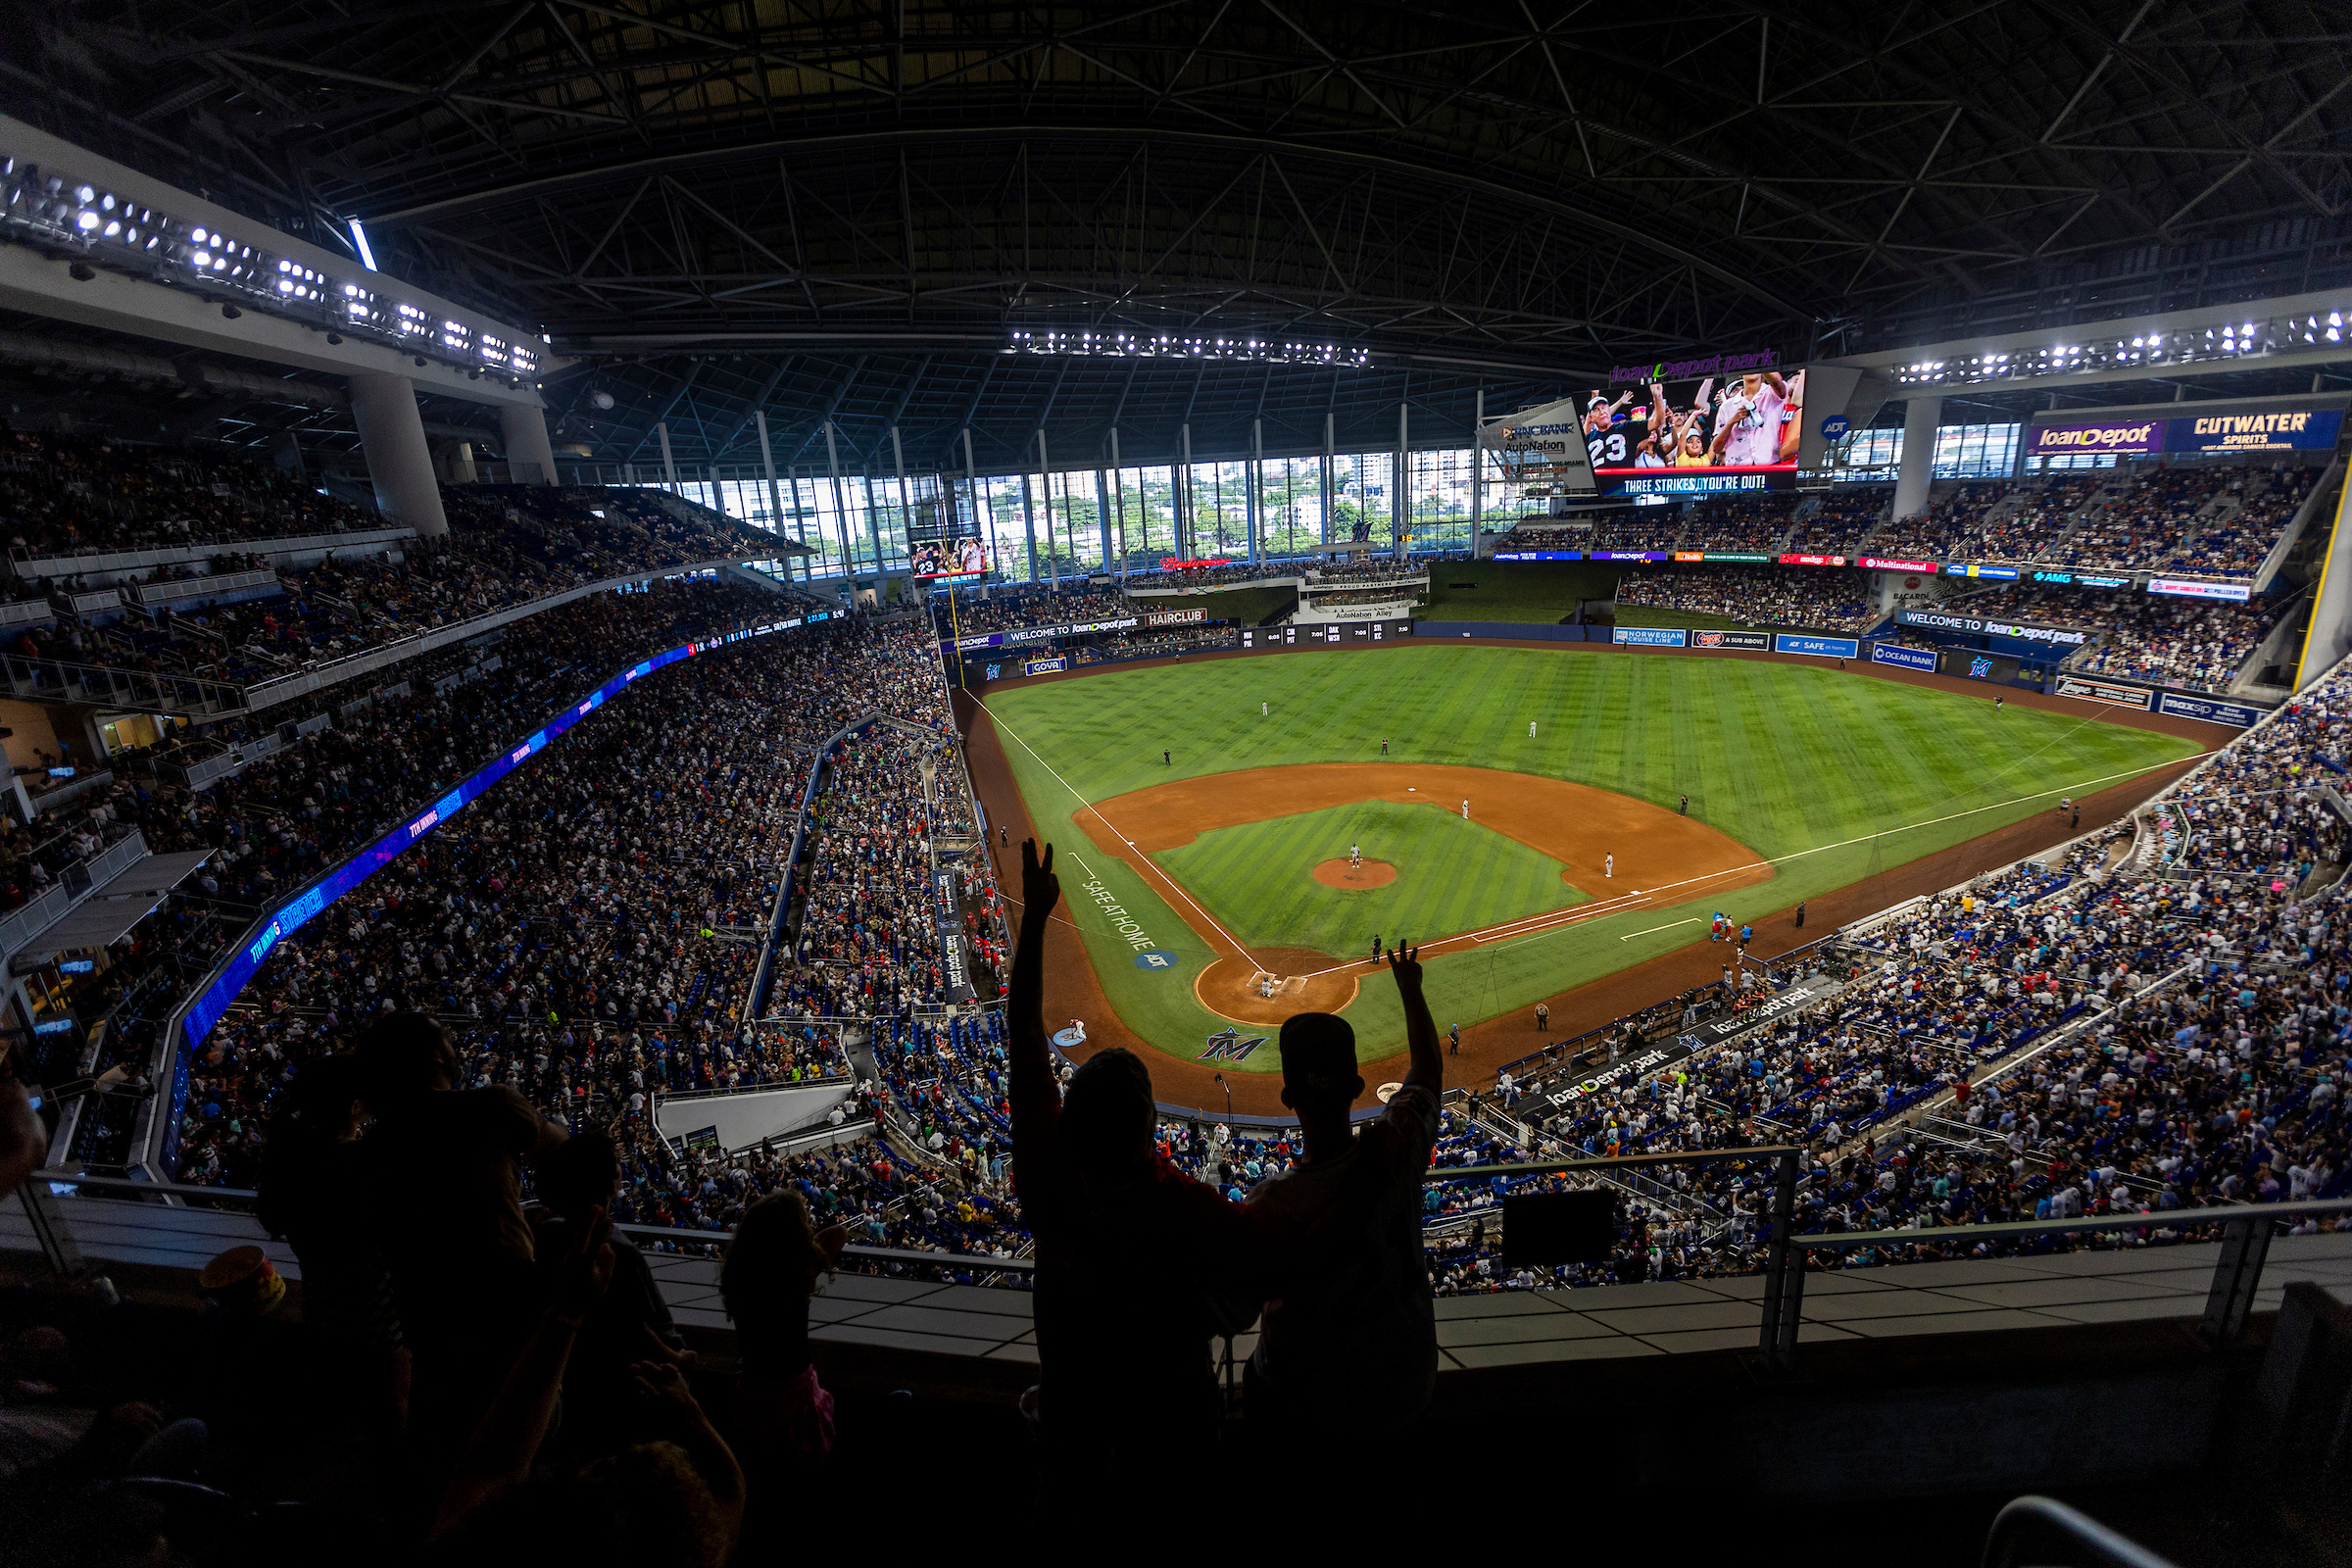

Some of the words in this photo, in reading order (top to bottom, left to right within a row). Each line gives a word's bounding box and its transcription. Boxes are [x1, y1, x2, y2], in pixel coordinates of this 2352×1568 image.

[1612, 354, 1720, 382] loanDepot
[1723, 348, 1777, 373] park
[1824, 421, 1846, 433] ADT
[2193, 413, 2307, 435] CUTWATER
[2038, 424, 2152, 447] loanDepot
[2223, 434, 2269, 445] SPIRITS
[1505, 440, 1564, 453] AutoNation
[1588, 433, 1628, 468] 23
[1625, 479, 1653, 493] THREE
[1655, 477, 1699, 492] STRIKES,
[1703, 475, 1738, 490] YOU'RE
[1740, 475, 1766, 489] OUT!
[1159, 557, 1231, 571] Budweiser
[1610, 552, 1645, 561] loanDepot
[1875, 560, 1927, 571] Multinational
[2043, 572, 2072, 584] AMG
[1149, 611, 1203, 625] HAIRCLUB
[1010, 626, 1056, 641] WELCOME
[1057, 626, 1069, 636] TO
[1072, 620, 1120, 634] loanDepot
[1118, 617, 1138, 628] park
[1628, 631, 1683, 639] NORWEGIAN
[1907, 612, 1962, 629] WELCOME
[1965, 619, 1981, 631] TO
[1984, 621, 2055, 641] loanDepot
[2052, 631, 2087, 645] park
[1804, 641, 1825, 651] SAFE
[1885, 651, 1911, 662] OCEAN
[1911, 655, 1933, 666] BANK
[1034, 661, 1059, 672] GOYA
[2165, 699, 2212, 715] maxsip
[2215, 710, 2246, 719] Internet
[409, 821, 422, 838] 7TH
[419, 809, 438, 831] INNING
[1082, 881, 1116, 905] SAFE
[1100, 905, 1127, 916] AT
[249, 941, 264, 964] 7TH
[260, 921, 281, 952] INNING
[278, 887, 324, 935] STRETCH
[1111, 916, 1156, 951] HOME
[945, 934, 963, 971] loanDepot
[1144, 954, 1169, 967] ADT
[946, 966, 966, 989] park
[1780, 986, 1816, 1007] park
